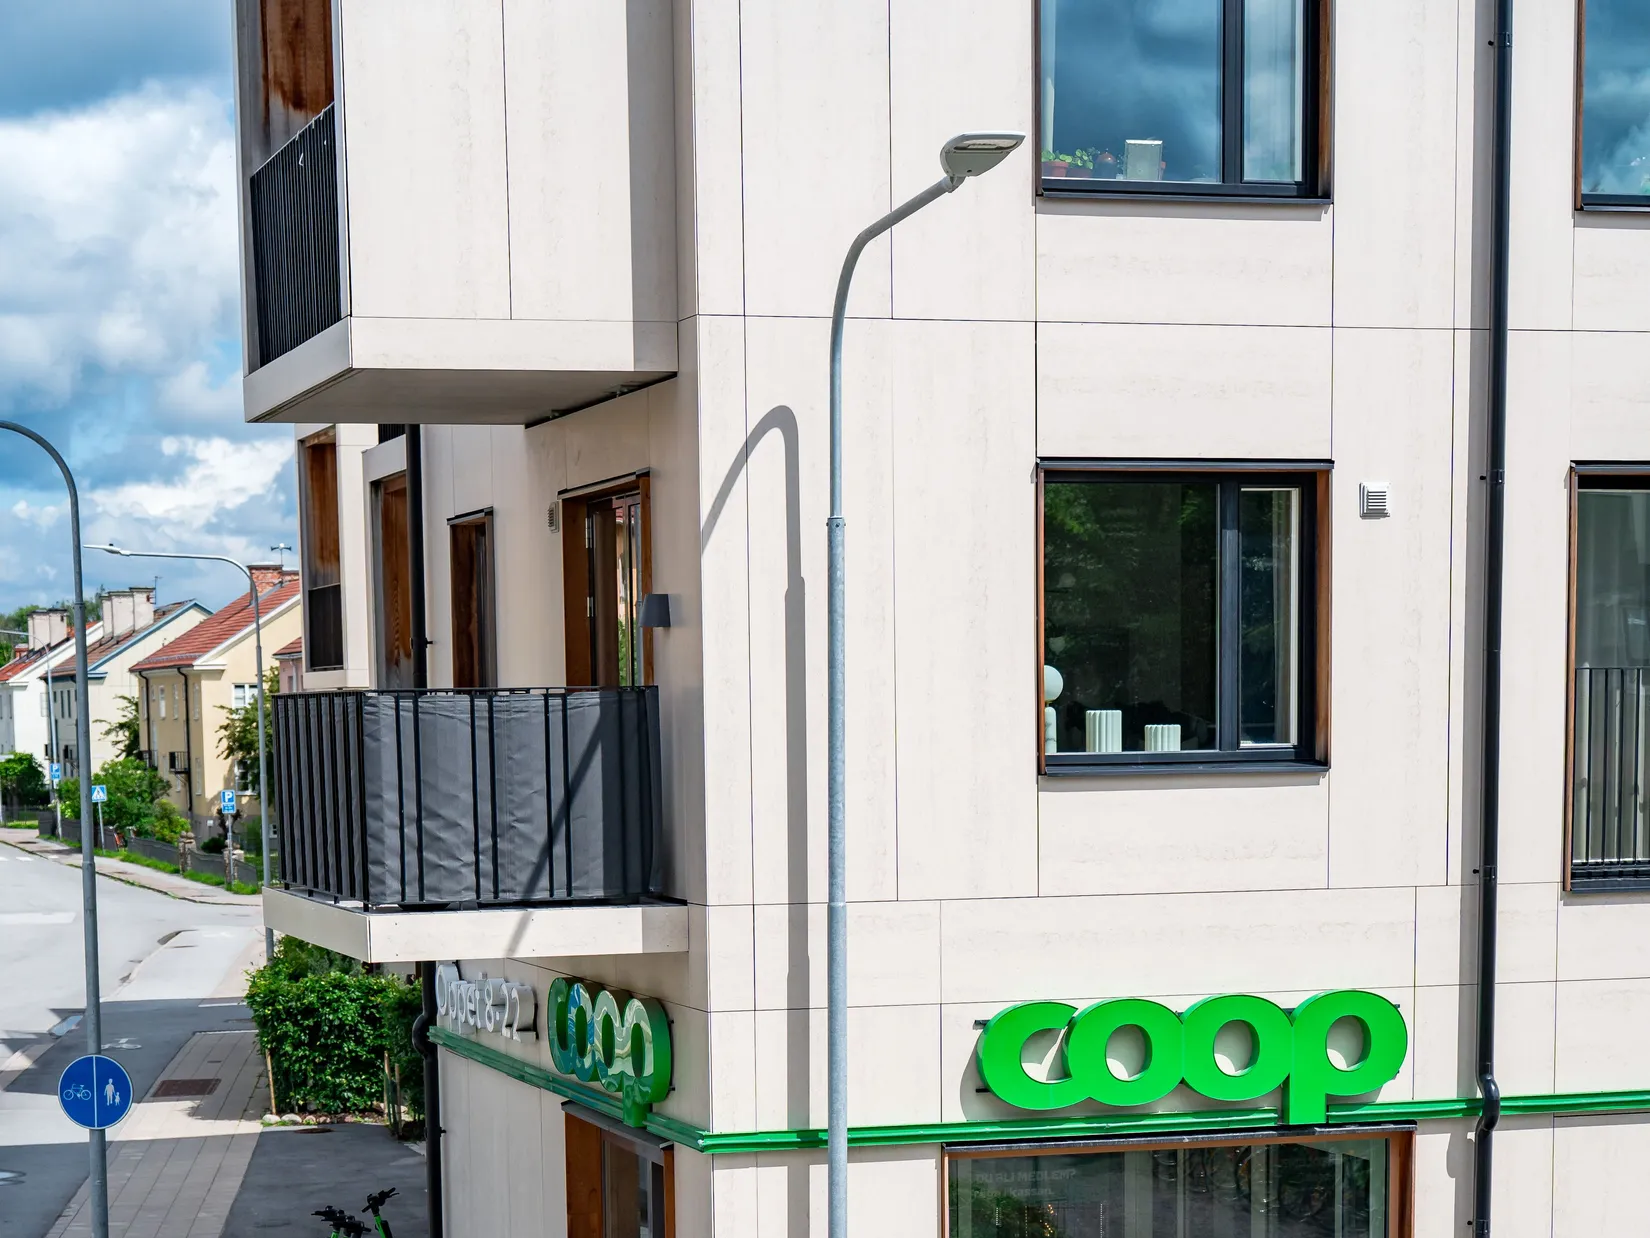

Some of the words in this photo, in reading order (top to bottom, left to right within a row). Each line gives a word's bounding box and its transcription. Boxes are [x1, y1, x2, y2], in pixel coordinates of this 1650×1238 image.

[224, 791, 233, 803] P
[548, 977, 672, 1128] coop
[975, 989, 1408, 1125] coop
